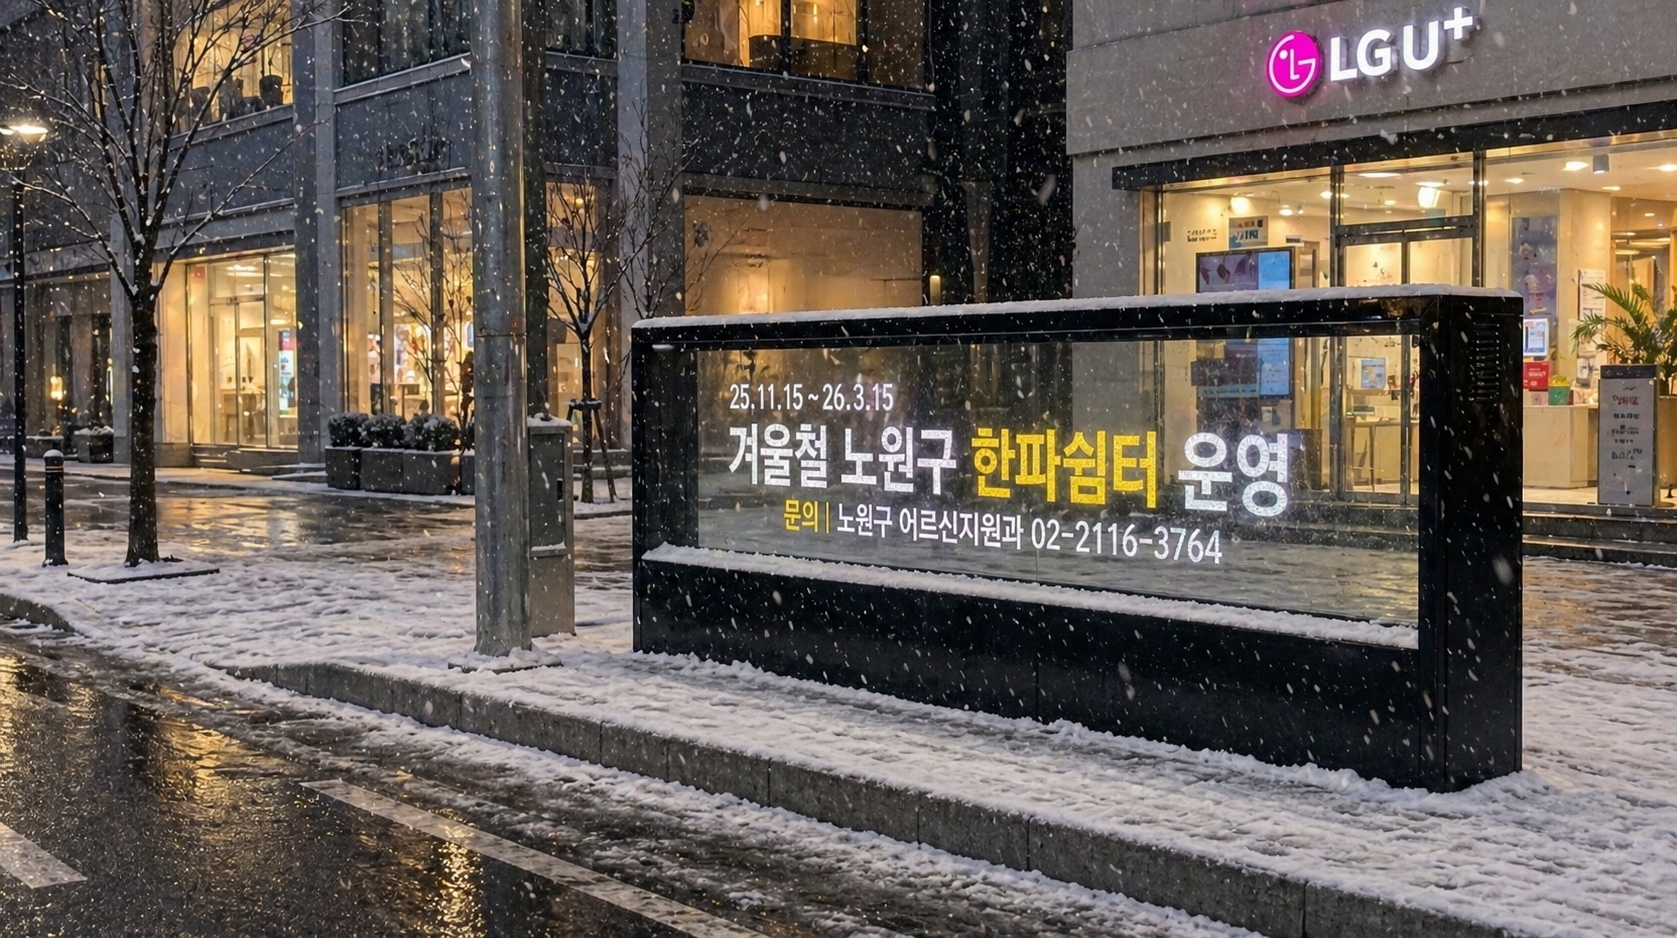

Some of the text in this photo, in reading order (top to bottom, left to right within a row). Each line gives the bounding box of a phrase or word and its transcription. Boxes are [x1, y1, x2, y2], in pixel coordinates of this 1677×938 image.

[1330, 7, 1473, 81] LG U+
[728, 423, 1289, 517] 겨울철 노원구 한파쉼터 운영
[783, 499, 819, 533] 문의
[837, 502, 893, 538] 노원구
[899, 507, 1024, 550] 어르신지원과
[1031, 517, 1223, 565] 02-2116-3764
